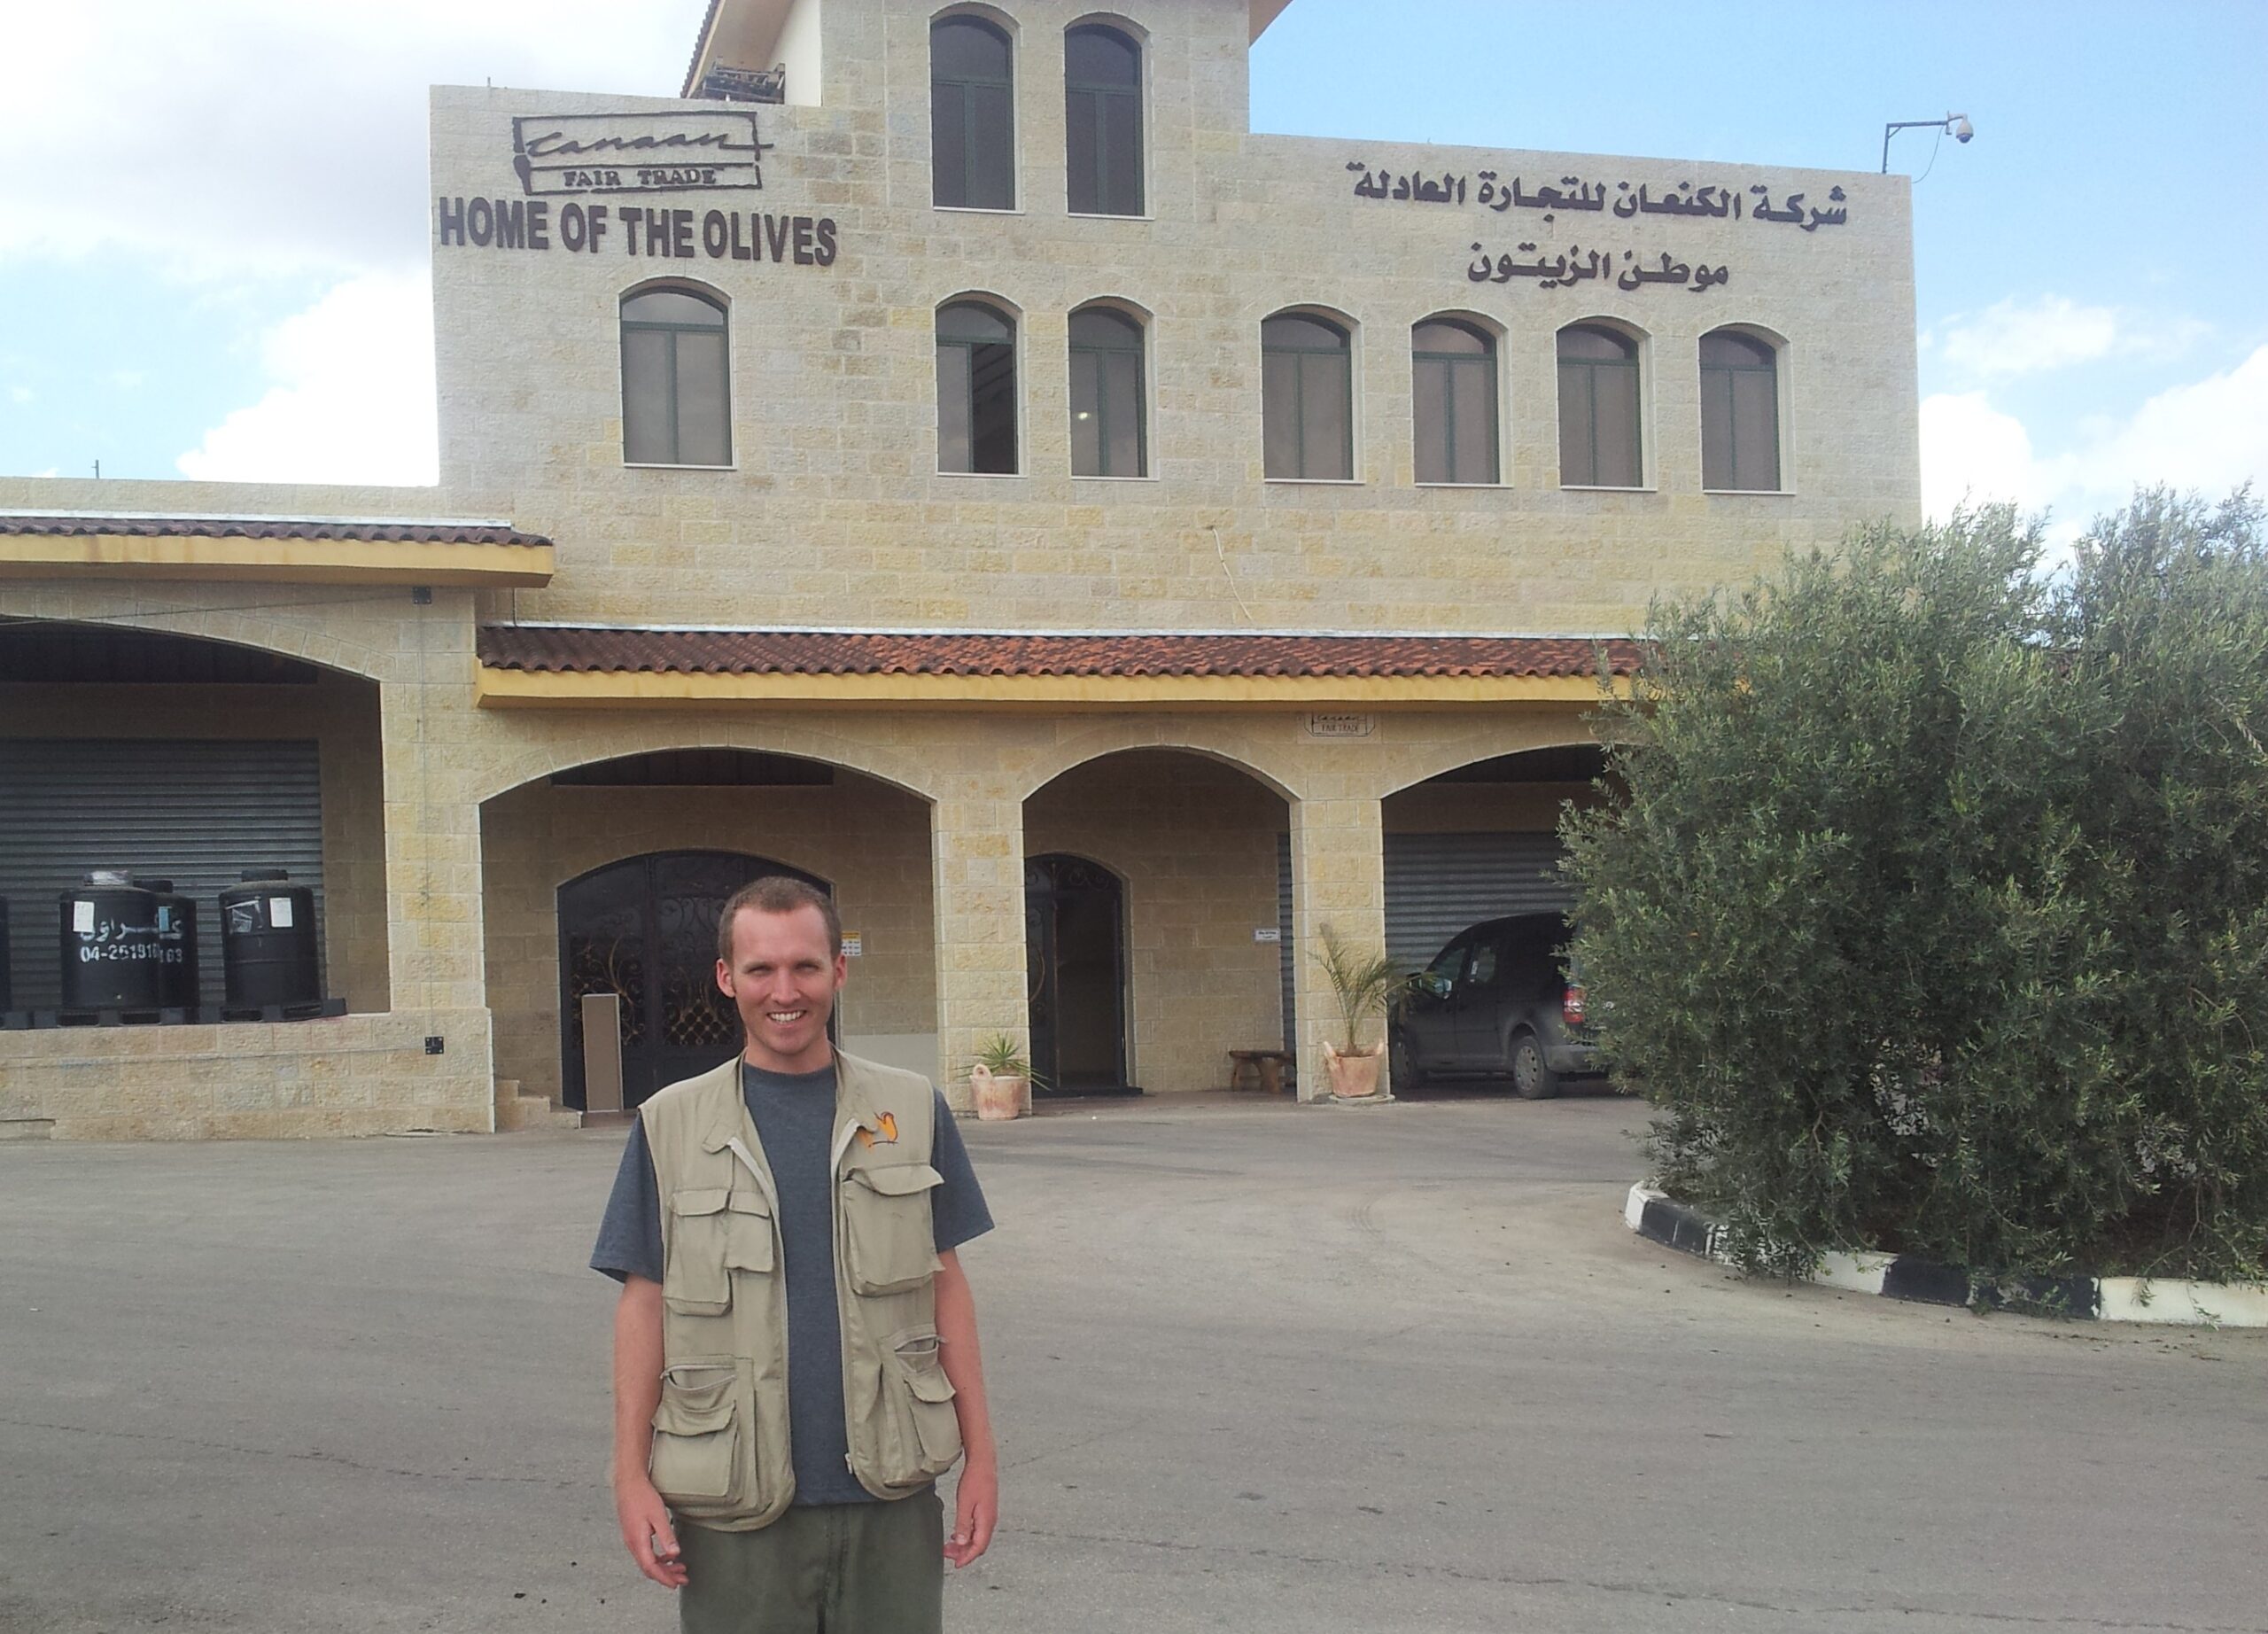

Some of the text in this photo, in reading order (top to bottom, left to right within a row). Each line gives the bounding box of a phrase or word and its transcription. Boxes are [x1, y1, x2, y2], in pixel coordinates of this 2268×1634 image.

[563, 168, 717, 187] FAIR TRADE
[1345, 161, 1847, 232] شركة الكنعان للتجارة العادلة
[439, 197, 837, 267] HOME OF THE OLIVES
[1467, 242, 1729, 293] موطن الزيتون
